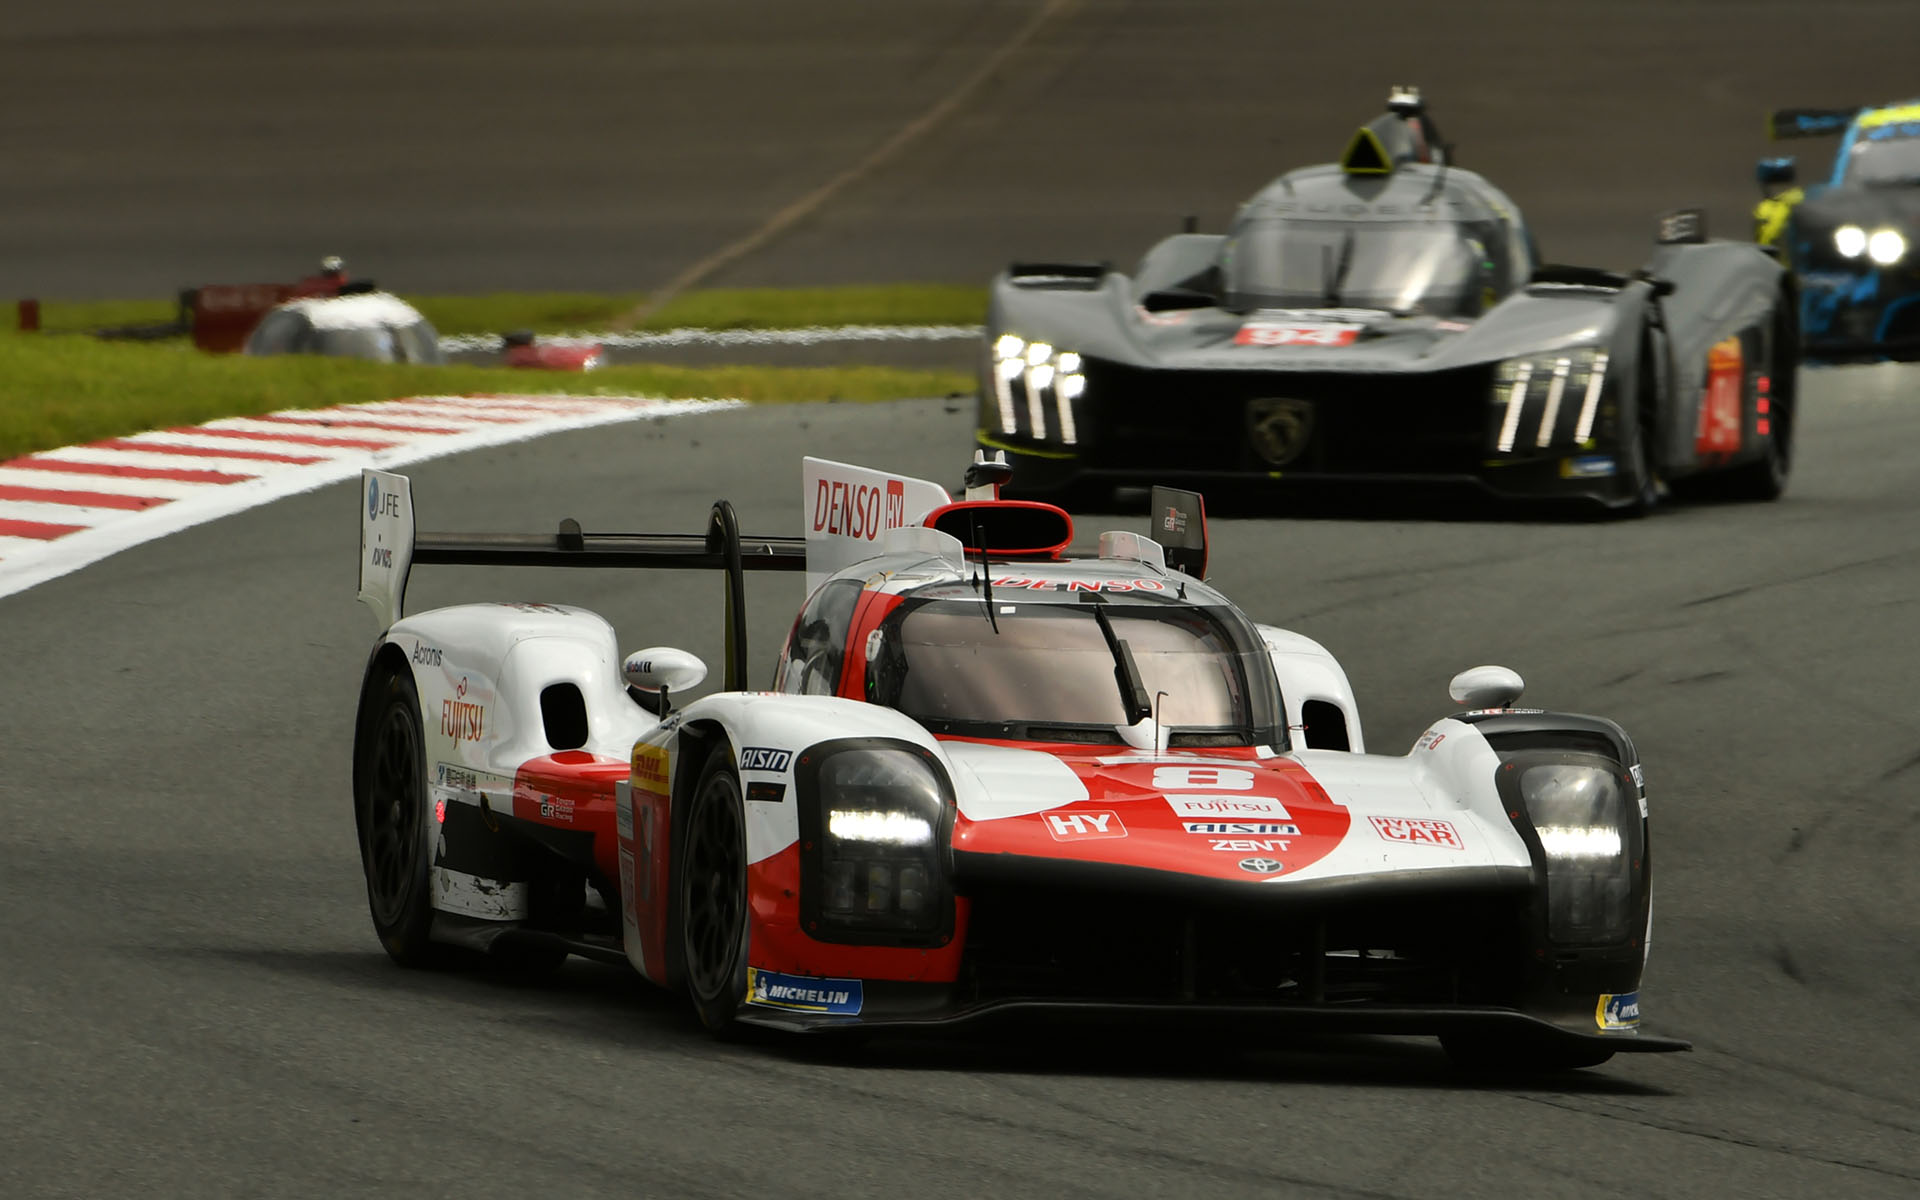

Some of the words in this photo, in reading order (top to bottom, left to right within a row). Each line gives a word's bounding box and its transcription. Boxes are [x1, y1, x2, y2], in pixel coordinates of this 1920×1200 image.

[379, 492, 399, 518] JFE
[814, 479, 881, 541] DENSO
[991, 577, 1165, 592] DENSO
[412, 639, 443, 667] Acronis
[440, 699, 484, 750] FUJITSU
[740, 749, 790, 770] AISIN
[1152, 766, 1255, 790] 8
[541, 804, 555, 817] GR
[1184, 801, 1272, 813] FUJITSU
[1048, 814, 1111, 835] HY
[1189, 824, 1296, 833] AISIN
[1375, 818, 1449, 831] HYPER
[1208, 839, 1292, 851] ZENT
[1382, 826, 1457, 846] CAR
[768, 985, 850, 1004] MICHELIN
